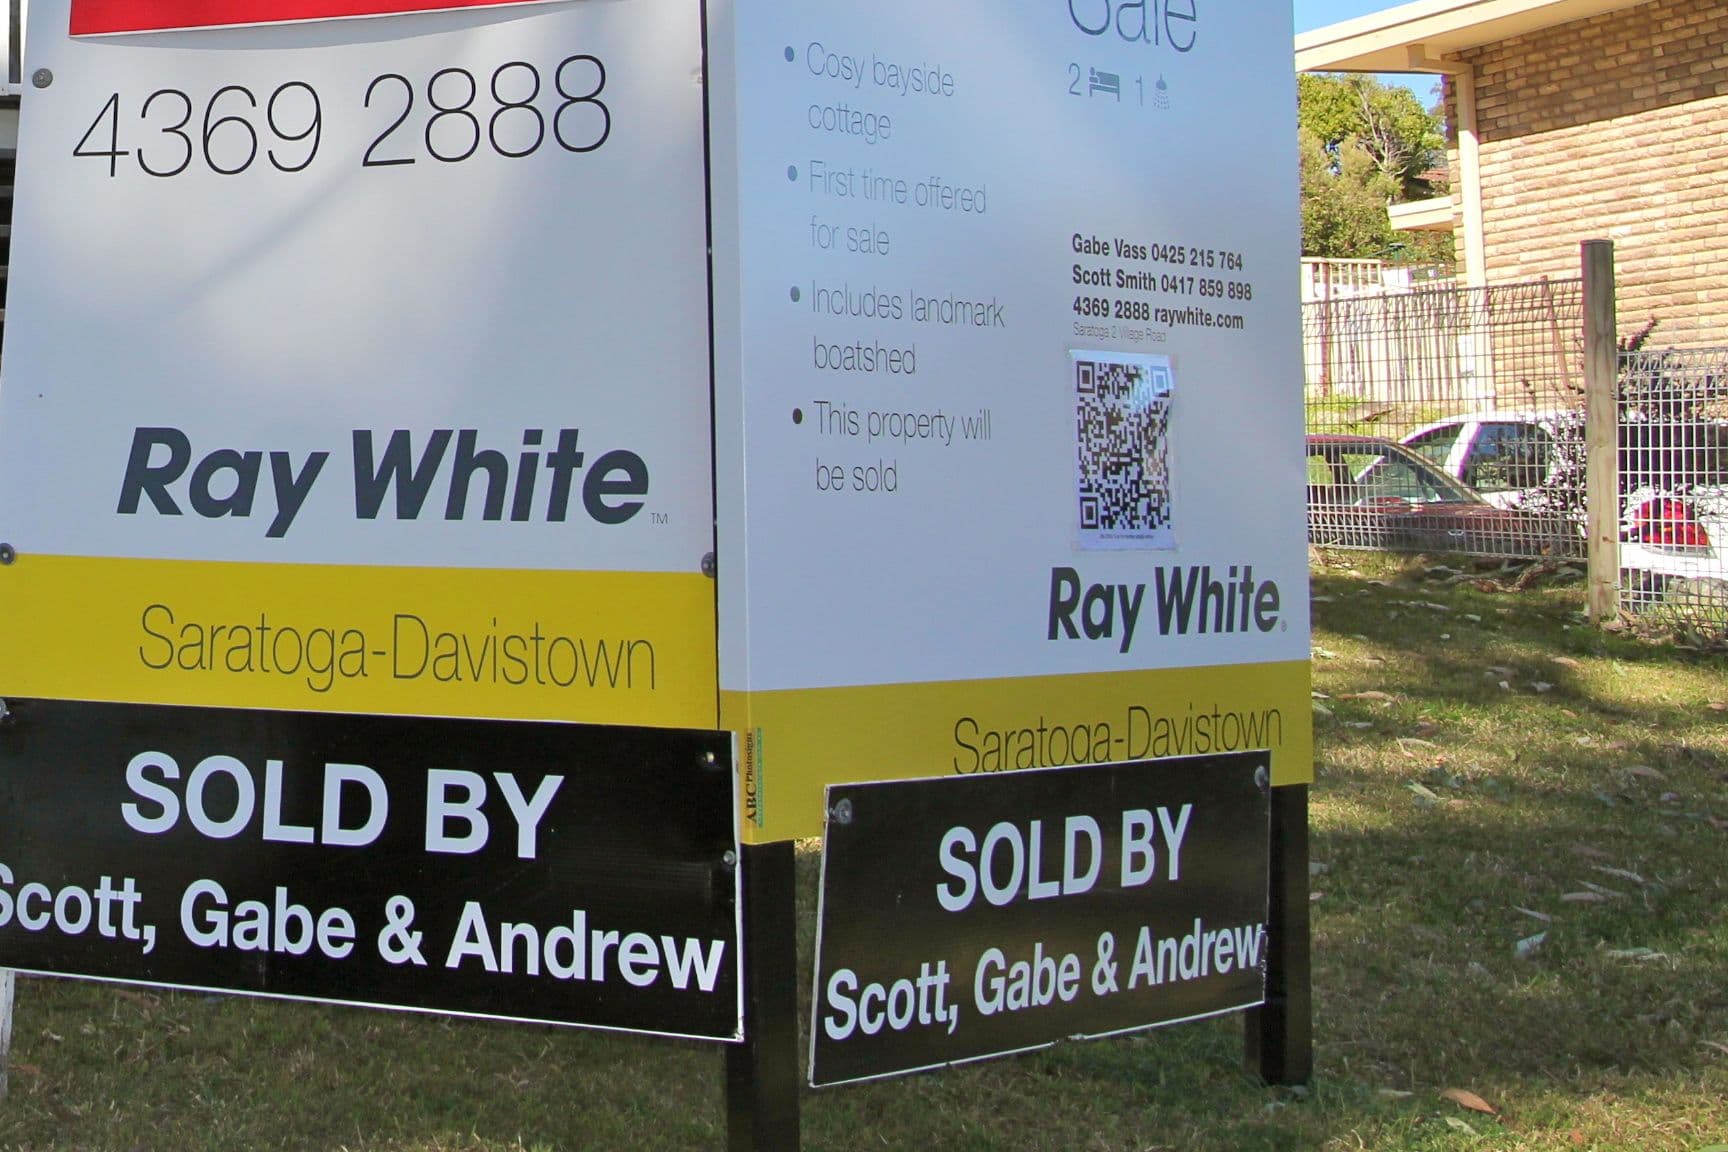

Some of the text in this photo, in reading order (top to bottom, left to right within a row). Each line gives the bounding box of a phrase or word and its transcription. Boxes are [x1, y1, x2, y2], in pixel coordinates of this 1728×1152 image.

[807, 42, 954, 97] Cosy bayside
[1068, 63, 1144, 106] 2 1
[72, 54, 611, 177] 4369 2888
[808, 102, 892, 144] cottage
[810, 161, 987, 215] First time offered
[810, 216, 890, 256] for sale
[1072, 233, 1243, 271] Gabe Vass 0425 215 764
[812, 279, 1006, 329] Includes landmark
[1072, 264, 1252, 301] Scott Smith 0417 859 898
[1073, 296, 1244, 330] 4369 2888 raywhite.com
[1073, 322, 1109, 341] Saratoga
[1146, 328, 1166, 342] Road
[814, 336, 916, 376] boatshed
[814, 400, 992, 447] This property will
[116, 427, 329, 538] Ray
[352, 428, 649, 525] White
[816, 458, 898, 493] be sold
[1047, 565, 1281, 654] Ray White
[140, 604, 655, 692] Saratoga-Davistown
[121, 751, 564, 859] SOLD BY
[936, 803, 1192, 912] SOLD BY
[180, 879, 356, 959] Gabe
[377, 894, 428, 967] &
[445, 901, 725, 992] Andrew
[824, 918, 1263, 1041] Scott, Gabe & Andrew
